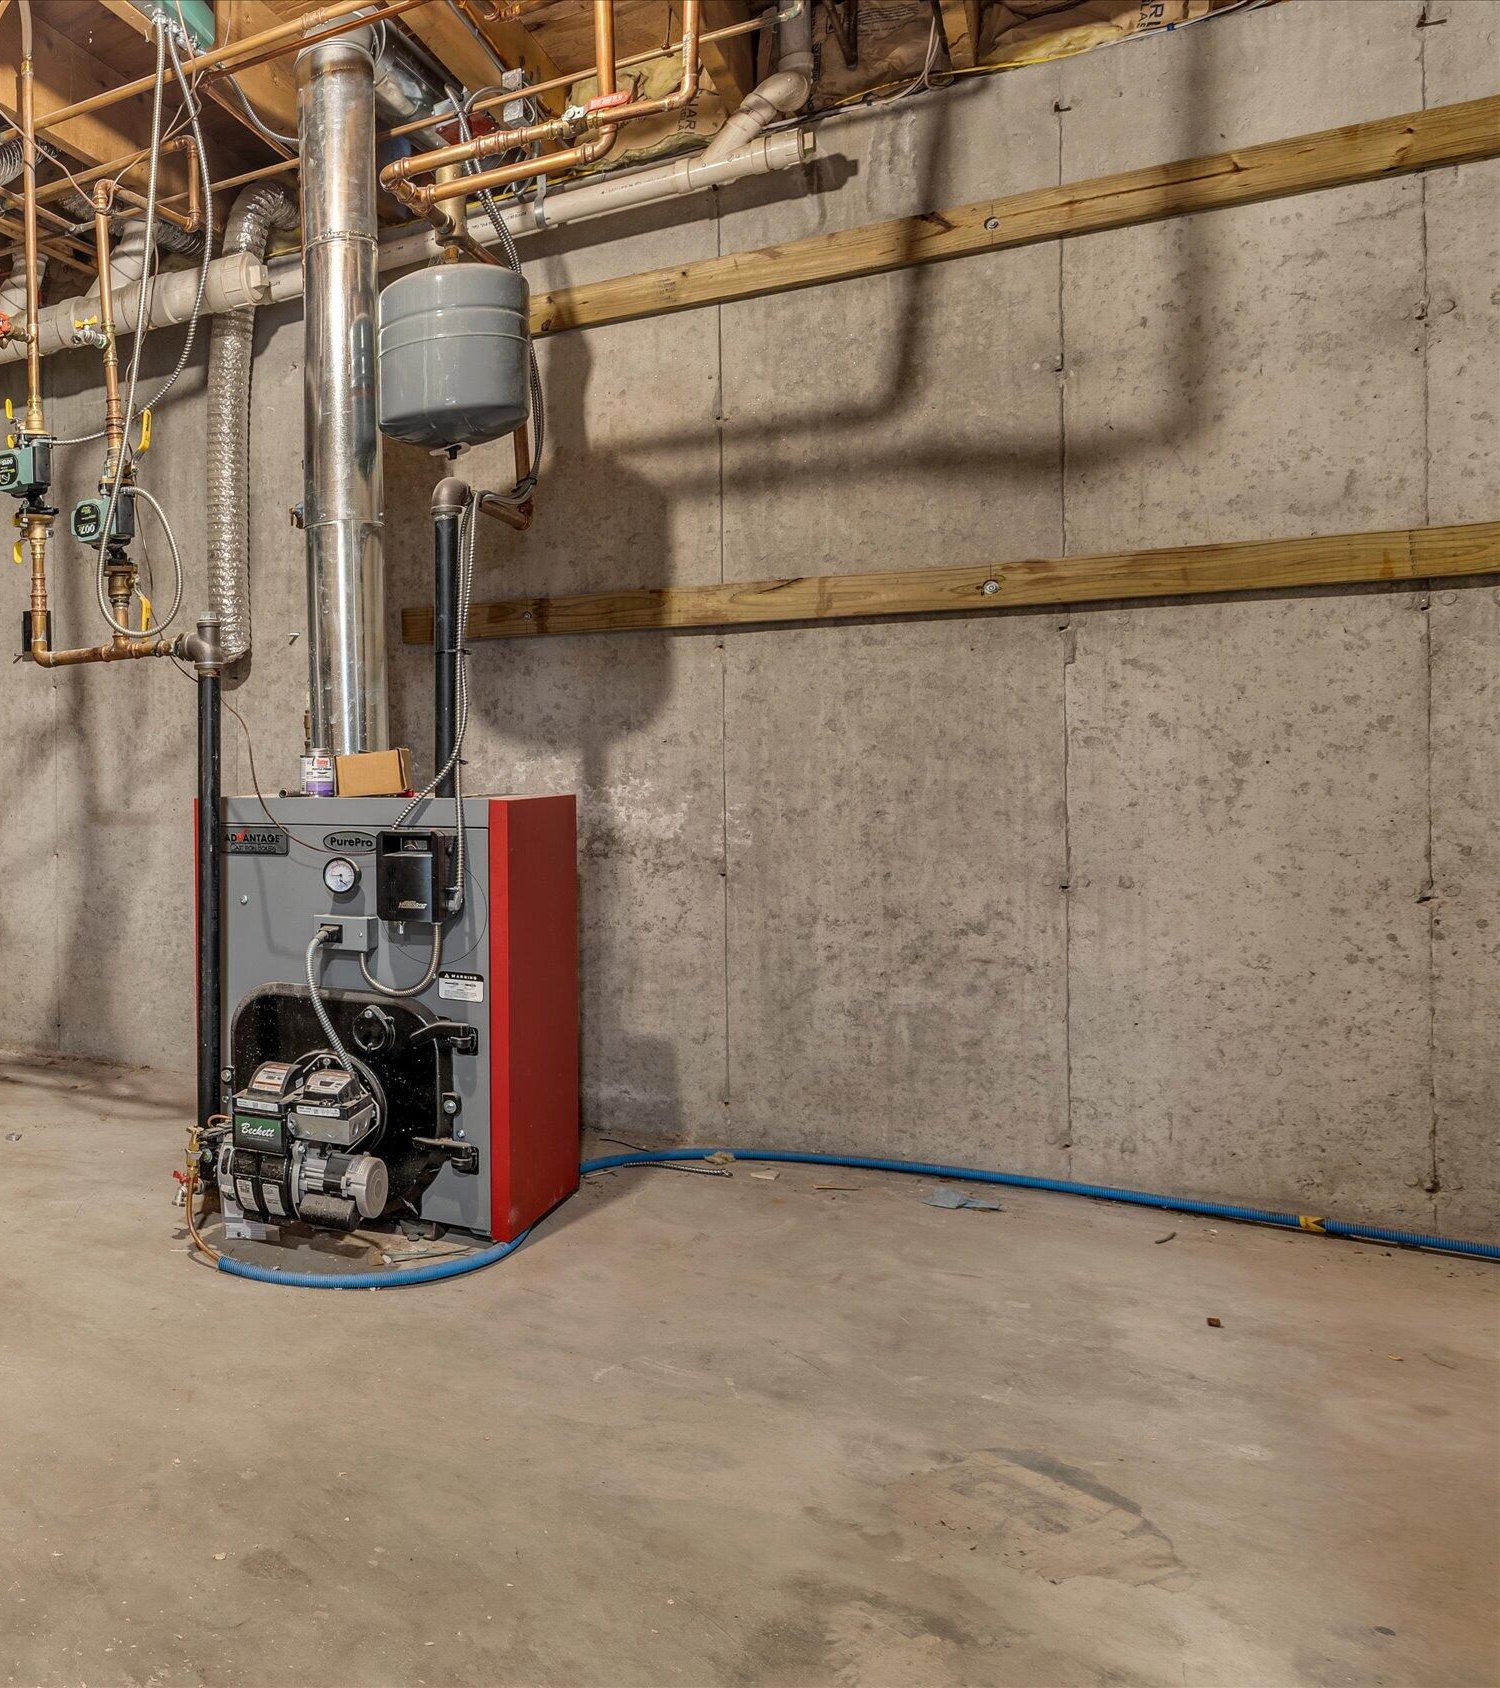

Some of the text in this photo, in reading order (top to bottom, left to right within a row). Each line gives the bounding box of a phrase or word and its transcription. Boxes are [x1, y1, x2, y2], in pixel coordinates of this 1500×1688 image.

[330, 837, 373, 847] PurePro
[451, 973, 477, 981] WARNING
[241, 1122, 275, 1138] Beckett
